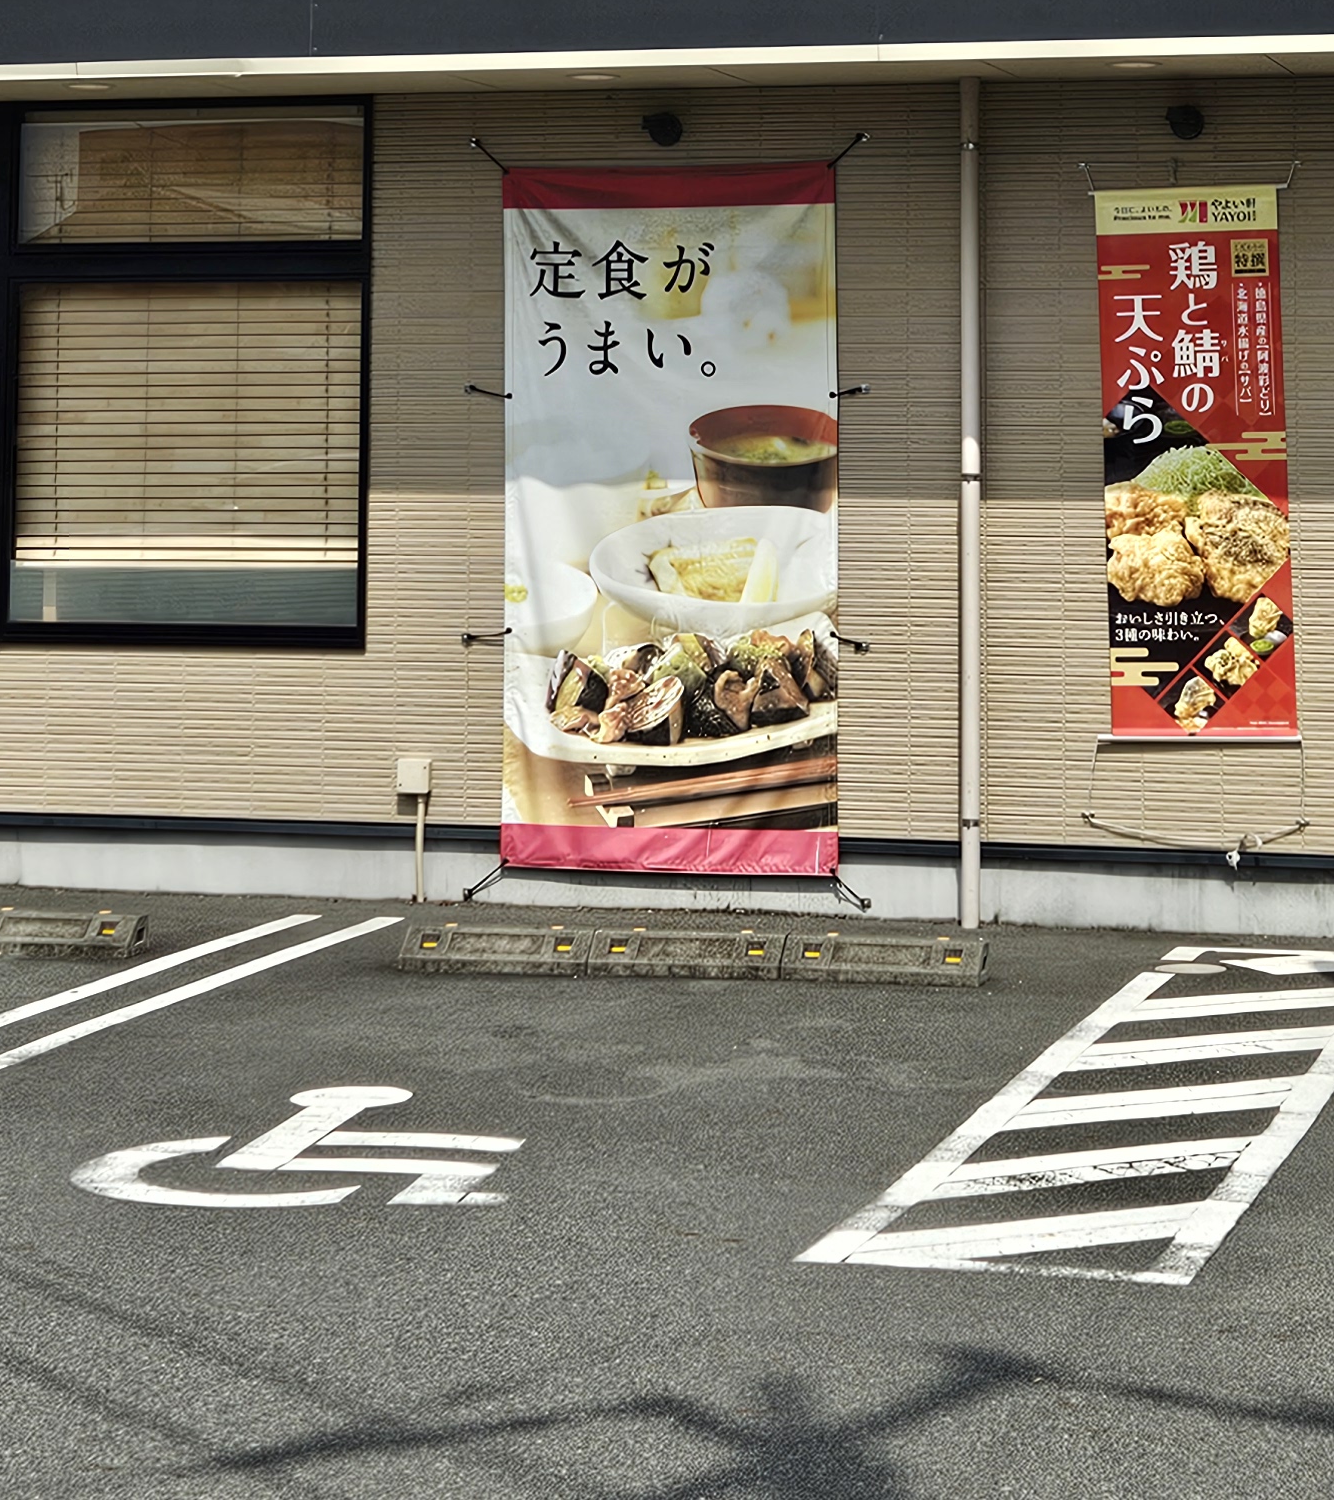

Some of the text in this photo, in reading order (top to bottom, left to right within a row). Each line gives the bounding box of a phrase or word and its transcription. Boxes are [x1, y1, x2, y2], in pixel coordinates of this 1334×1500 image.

[529, 240, 714, 301] 定食が
[537, 321, 717, 378] うまい。
[1114, 295, 1165, 444] 天ぷら
[1169, 241, 1220, 412] 鶏と鯖の
